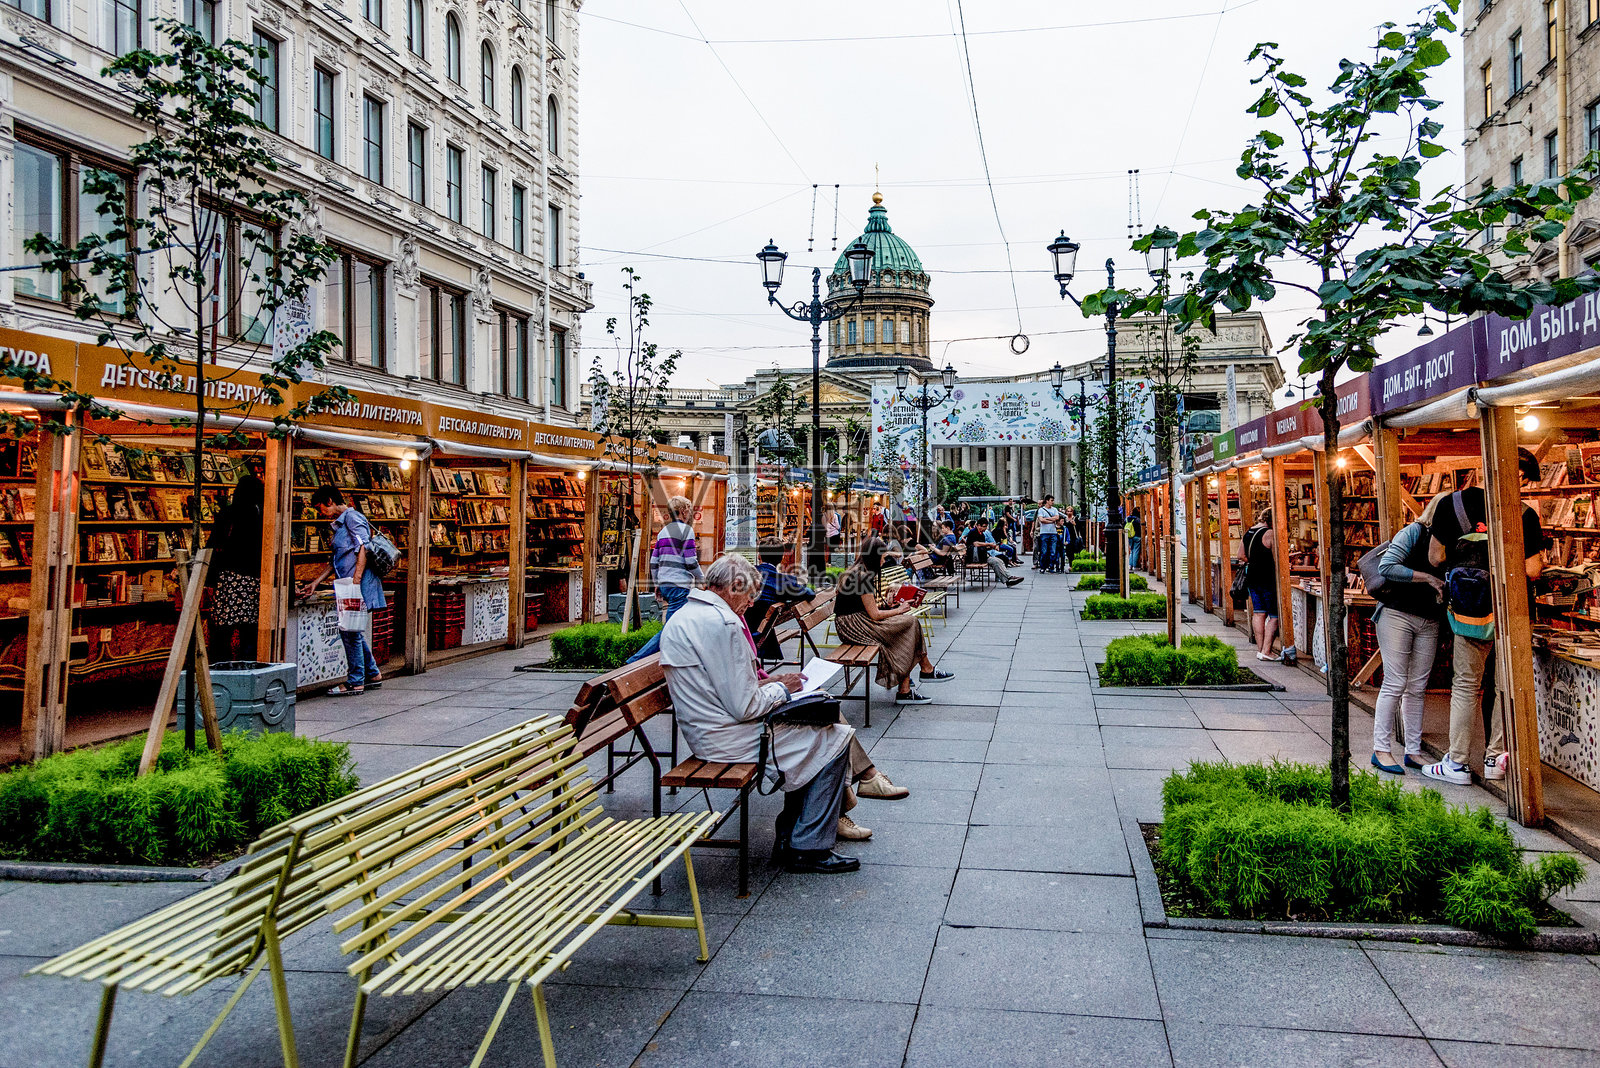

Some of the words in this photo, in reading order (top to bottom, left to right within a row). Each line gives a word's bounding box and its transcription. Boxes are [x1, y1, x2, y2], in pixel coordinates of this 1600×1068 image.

[1500, 319, 1537, 364] ДОМ.
[1541, 301, 1580, 343] БЫТ.
[1383, 373, 1403, 404] ДОМ.
[1404, 363, 1423, 393] БЫТ.
[1424, 350, 1455, 390] ДОСУГ
[361, 403, 423, 425] ЛИТЕРАТУРА
[439, 416, 477, 435] ДЕТСКАЯ
[477, 423, 522, 441] ЛИТЕРАТУРА
[534, 432, 563, 446] ДЕТСКАЯ
[562, 435, 596, 450] ЛИТЕРАТУРА
